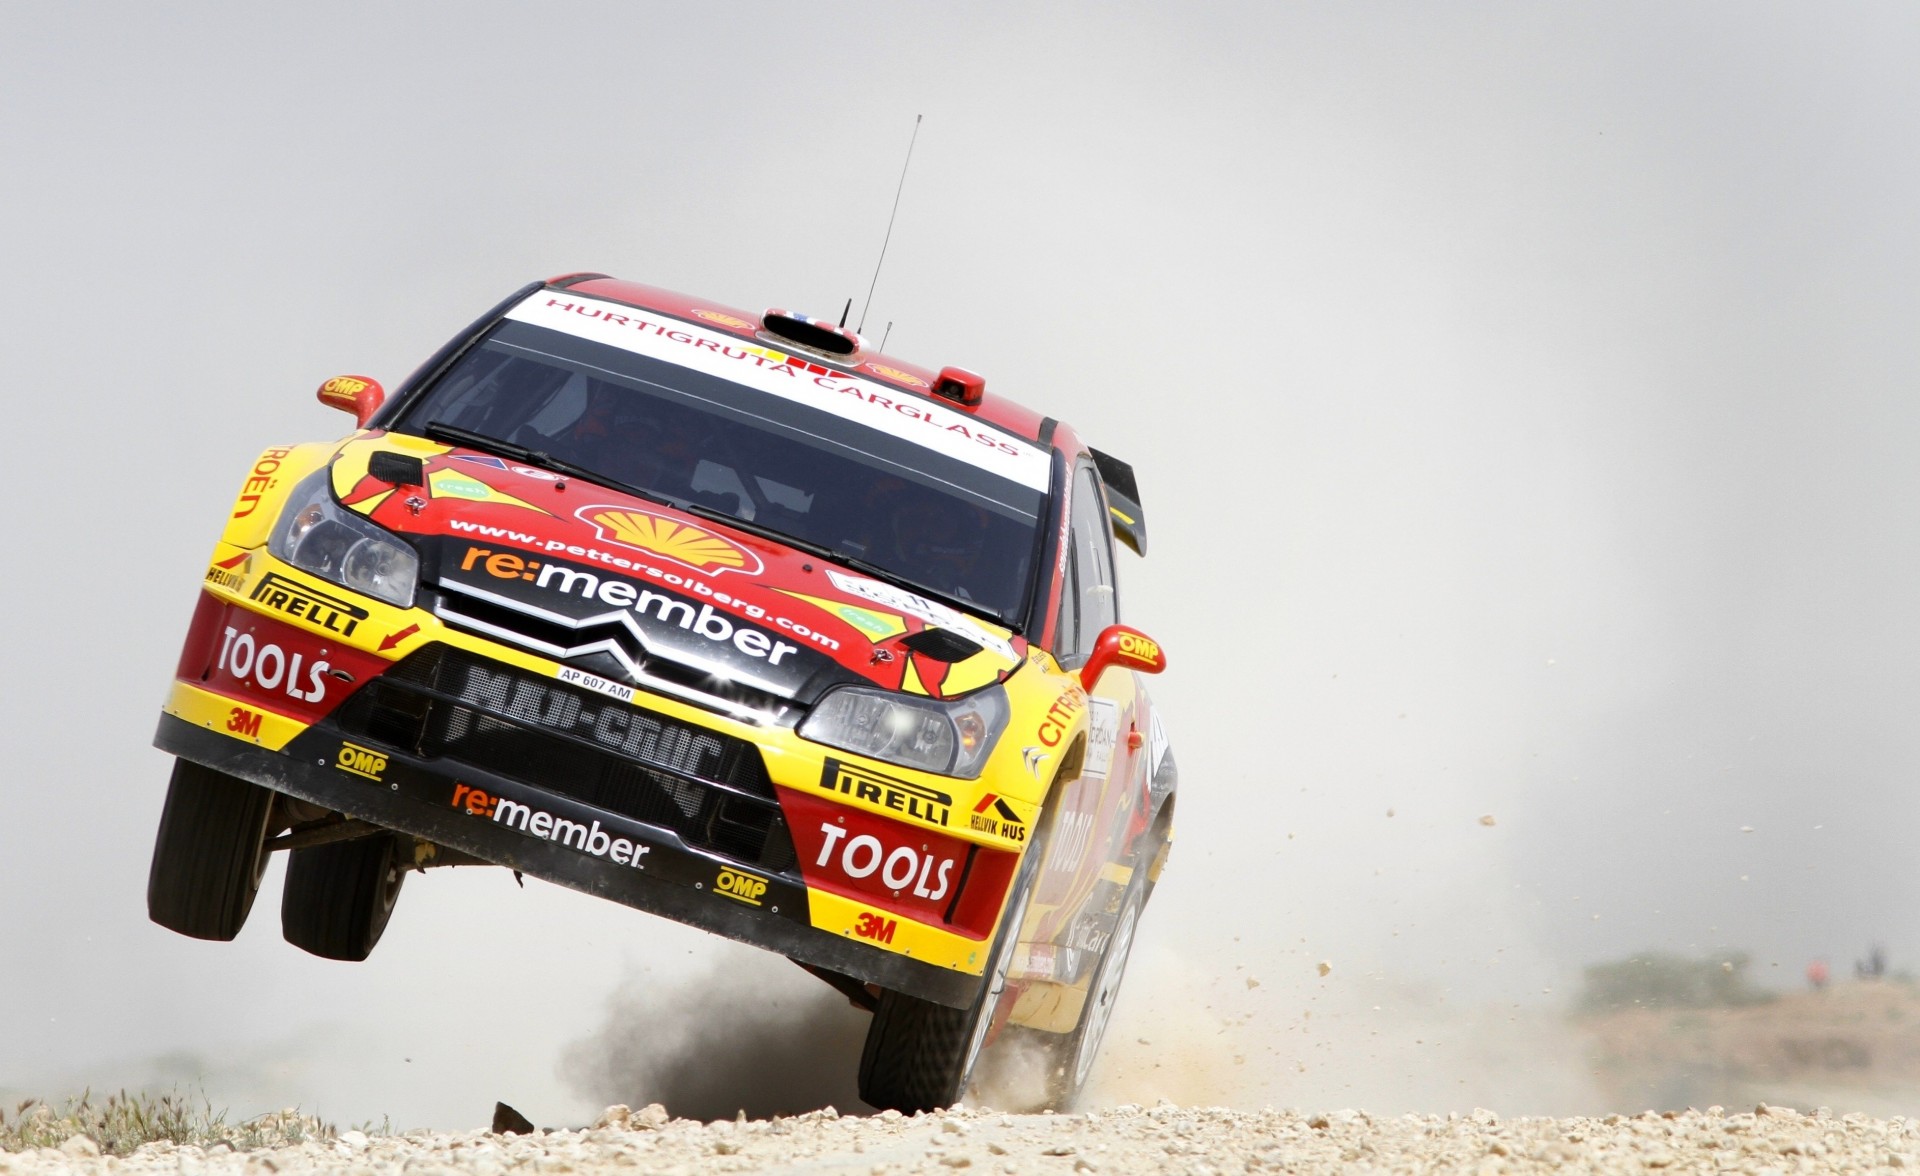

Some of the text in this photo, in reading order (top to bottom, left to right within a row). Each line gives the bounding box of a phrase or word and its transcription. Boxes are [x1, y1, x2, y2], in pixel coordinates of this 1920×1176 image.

[325, 377, 366, 399] OMP
[546, 298, 1020, 457] HURTIGRUTA CARGLASS
[439, 482, 486, 496] fresh
[449, 519, 842, 652] www.pettersolberg.com
[249, 572, 369, 637] PIRELLI
[461, 547, 798, 665] re:member
[842, 607, 886, 634] fresh
[1119, 635, 1160, 660] OMP
[217, 627, 331, 703] TOOLS
[561, 668, 632, 701] AP 607 AM
[227, 707, 262, 738] 3M
[338, 747, 387, 775] OMP
[819, 756, 954, 827] PIRELLI
[451, 783, 650, 868] re:member
[970, 812, 1026, 842] HELLVIK HUS
[815, 822, 954, 901] TOOLS
[716, 872, 767, 900] OMP
[854, 912, 898, 945] 3M
